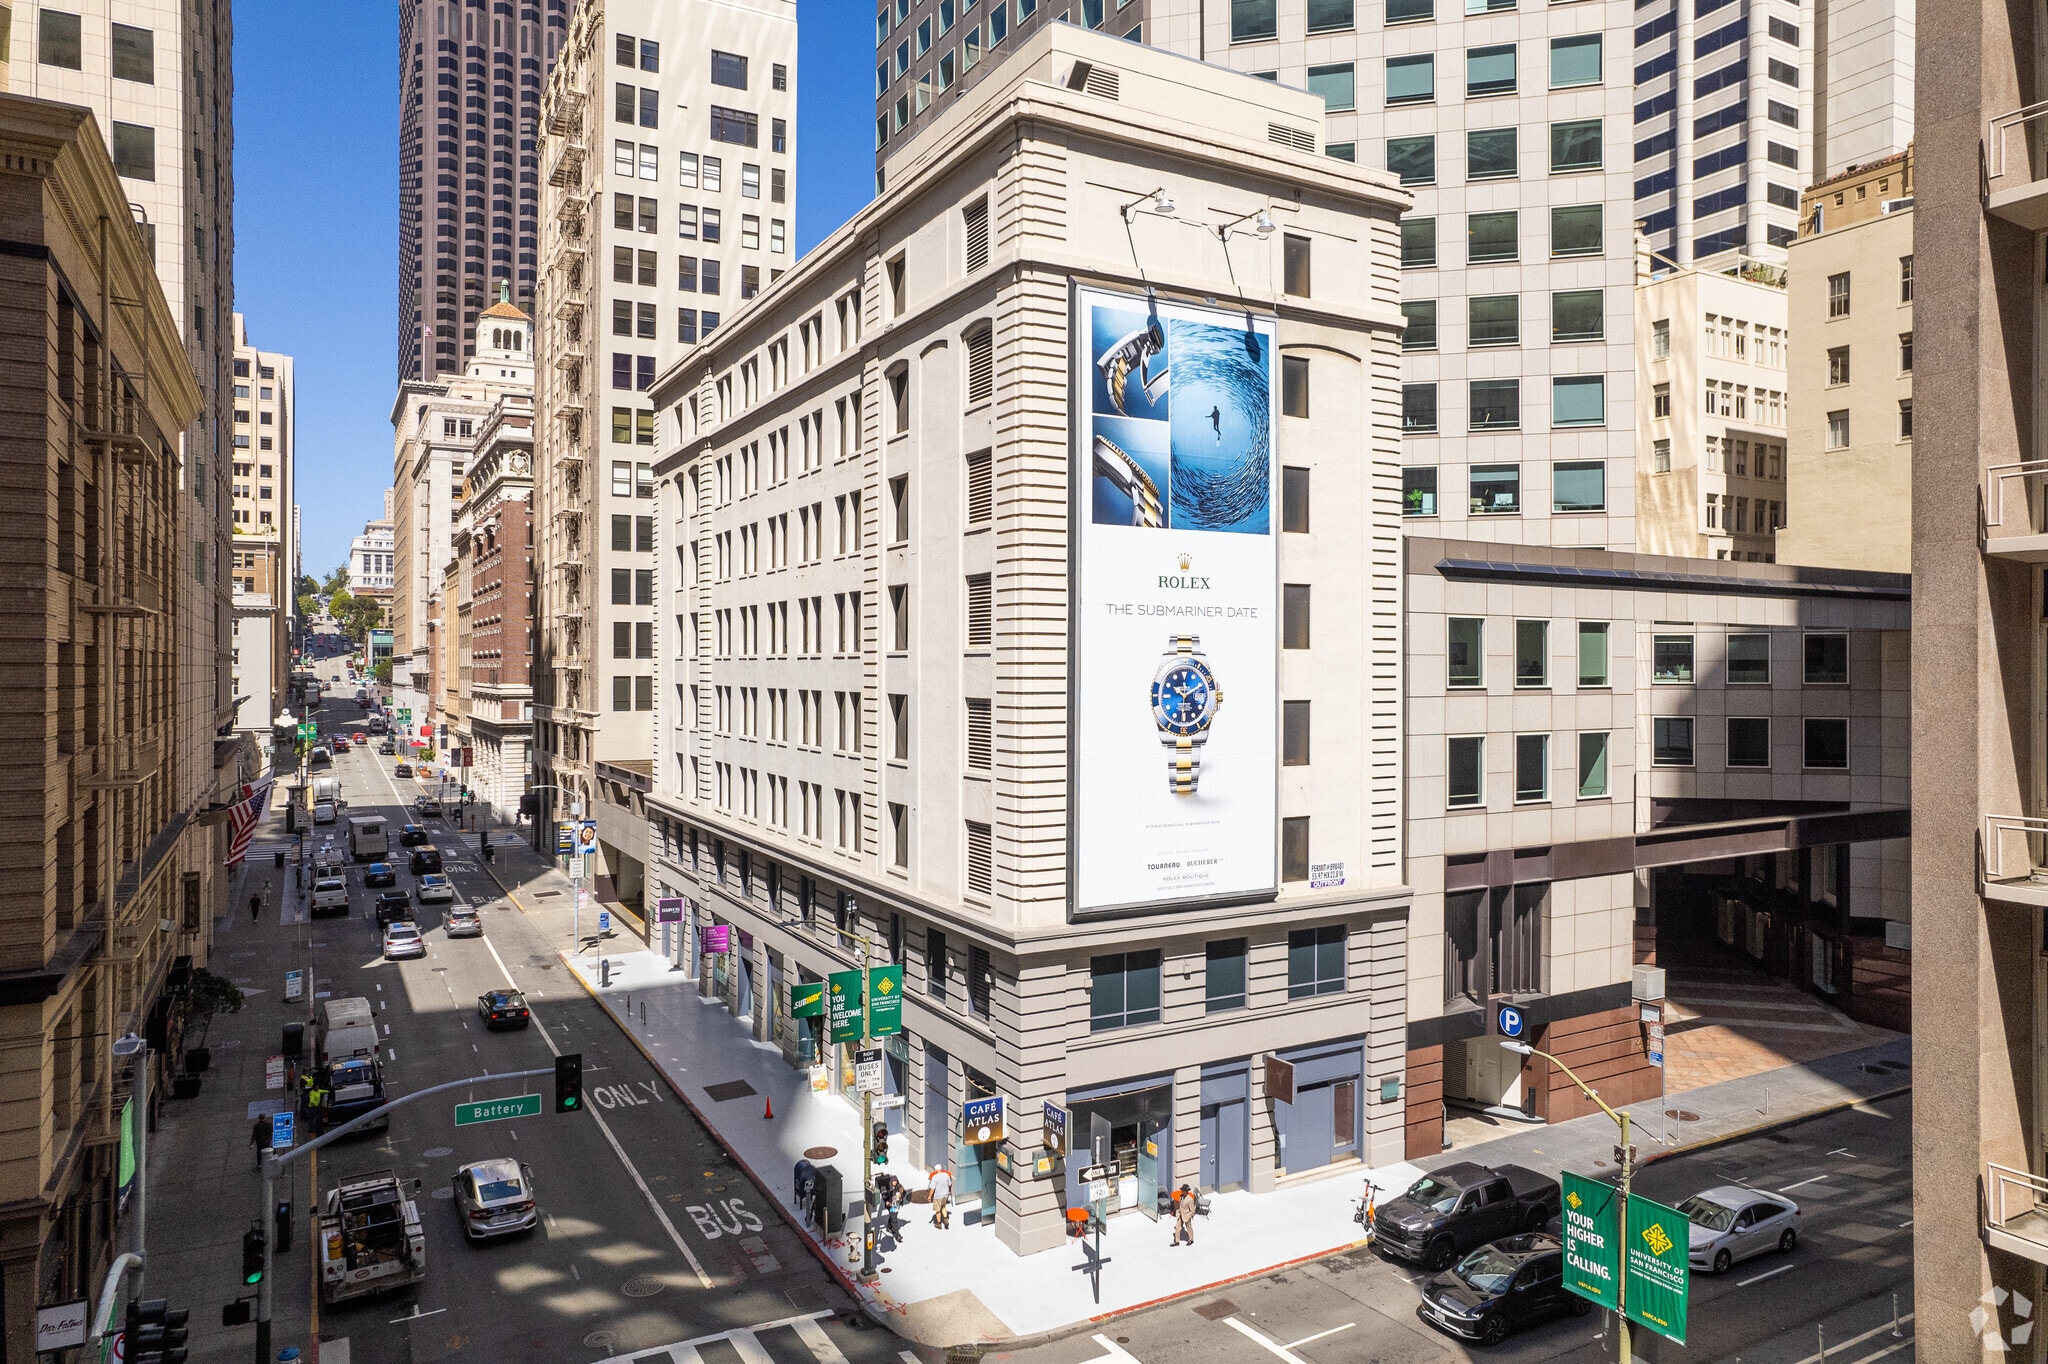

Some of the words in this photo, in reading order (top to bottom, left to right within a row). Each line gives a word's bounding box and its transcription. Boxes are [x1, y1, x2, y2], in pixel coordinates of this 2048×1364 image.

[1158, 576, 1210, 589] ROLEX
[1106, 604, 1133, 615] THE
[1138, 604, 1223, 618] SUBMARINER
[1227, 607, 1258, 618] DATE
[1148, 862, 1180, 870] TOURNEAU
[1186, 858, 1218, 867] BUCHERER
[471, 896, 503, 904] BUS
[793, 991, 822, 1010] SUBWAY
[832, 995, 845, 1003] YOU
[832, 1003, 845, 1011] ARE
[832, 1008, 862, 1020] WELCOME
[832, 1020, 850, 1029] HERE.
[1506, 1010, 1519, 1032] P
[859, 1062, 879, 1071] BUSES
[594, 1080, 664, 1108] ONLY
[474, 1103, 524, 1118] Battery
[970, 1101, 996, 1115] CAFÉ
[1046, 1108, 1062, 1123] CAFÉ
[967, 1114, 1000, 1128] ATLAS
[1045, 1119, 1064, 1136] ATLAS
[685, 1198, 763, 1240] BUS
[1567, 1210, 1594, 1230] YOUR
[1567, 1224, 1604, 1248] HIGHER
[1567, 1238, 1576, 1251] IS
[1567, 1253, 1611, 1280] CALLING.
[1630, 1248, 1672, 1271] UNIVERSITY
[1674, 1267, 1685, 1276] OF
[1630, 1257, 1644, 1267] SAN
[1645, 1262, 1684, 1284] FRANCISCO
[1642, 1311, 1668, 1326] USFCA.EDU
